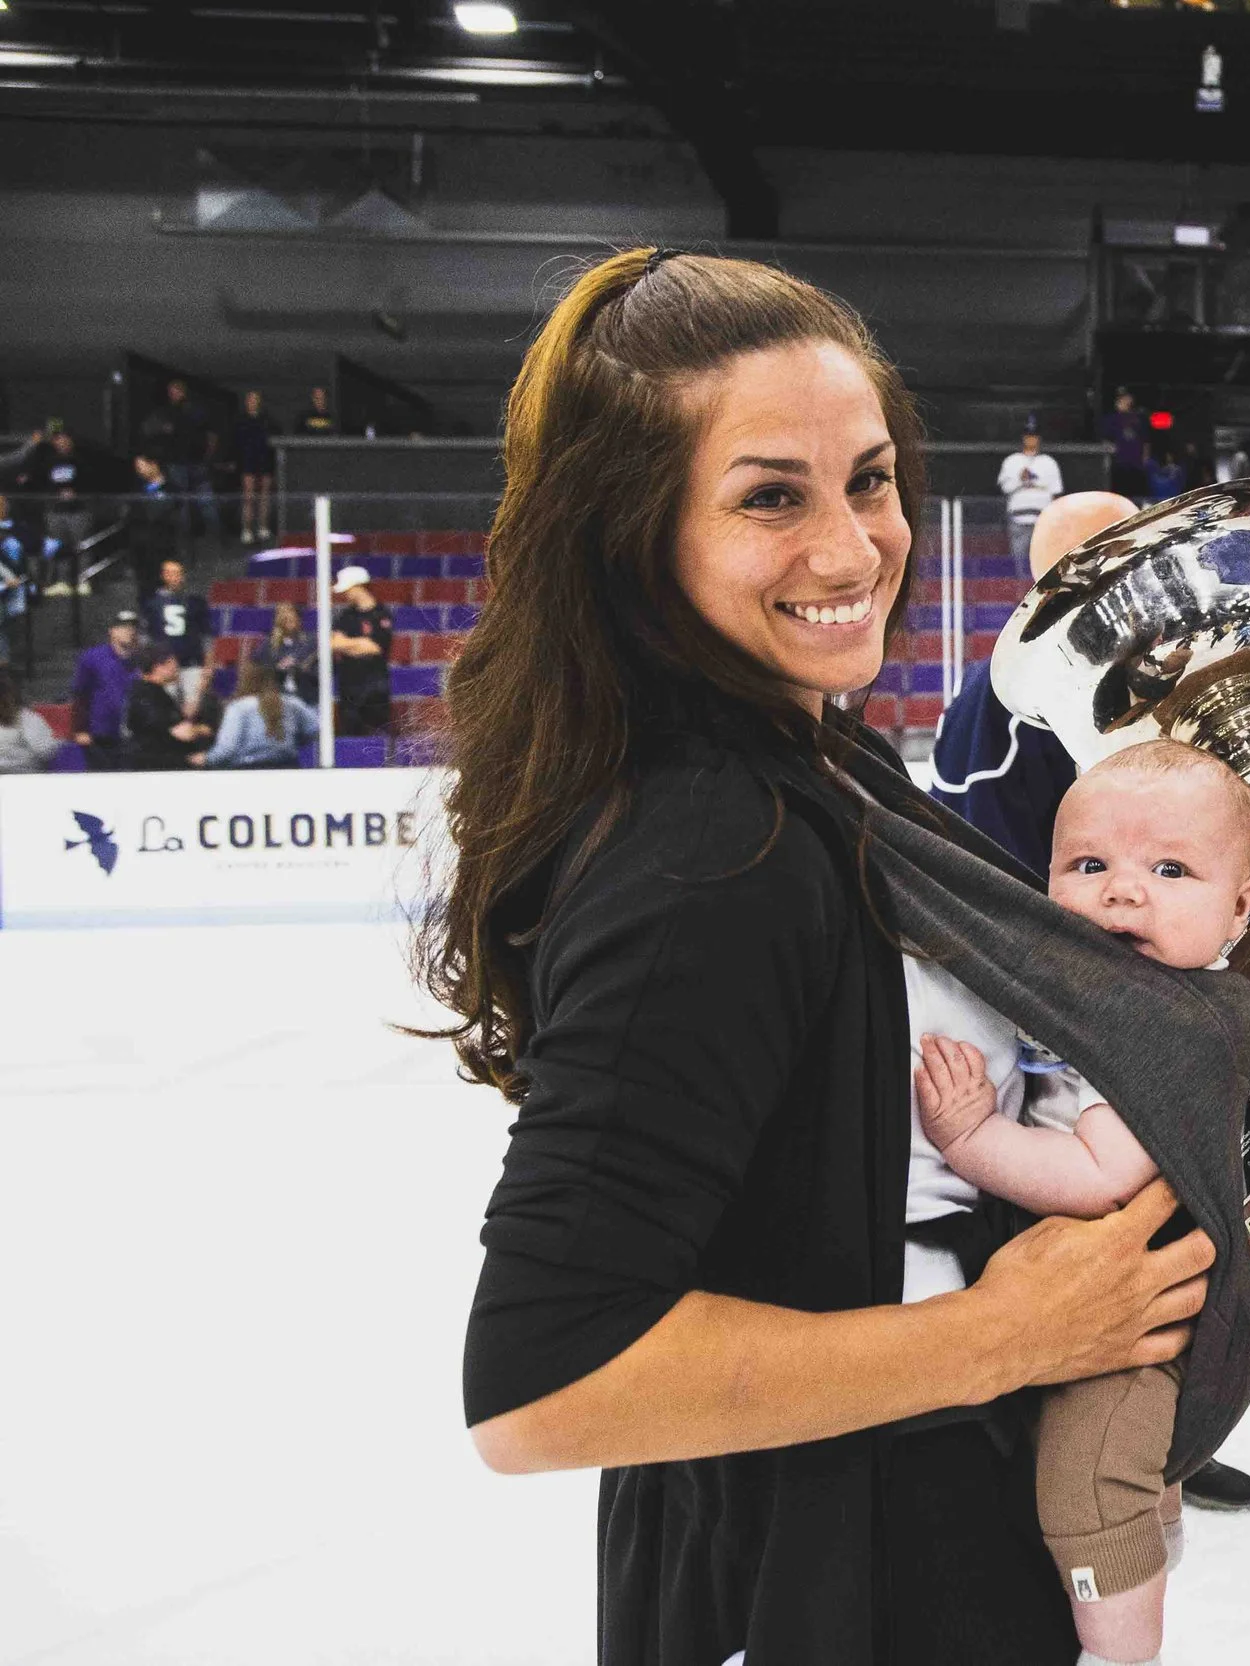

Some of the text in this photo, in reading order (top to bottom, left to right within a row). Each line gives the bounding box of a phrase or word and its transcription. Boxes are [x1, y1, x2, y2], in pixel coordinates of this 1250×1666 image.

[162, 605, 187, 637] 5
[137, 811, 421, 853] La COLOMBE
